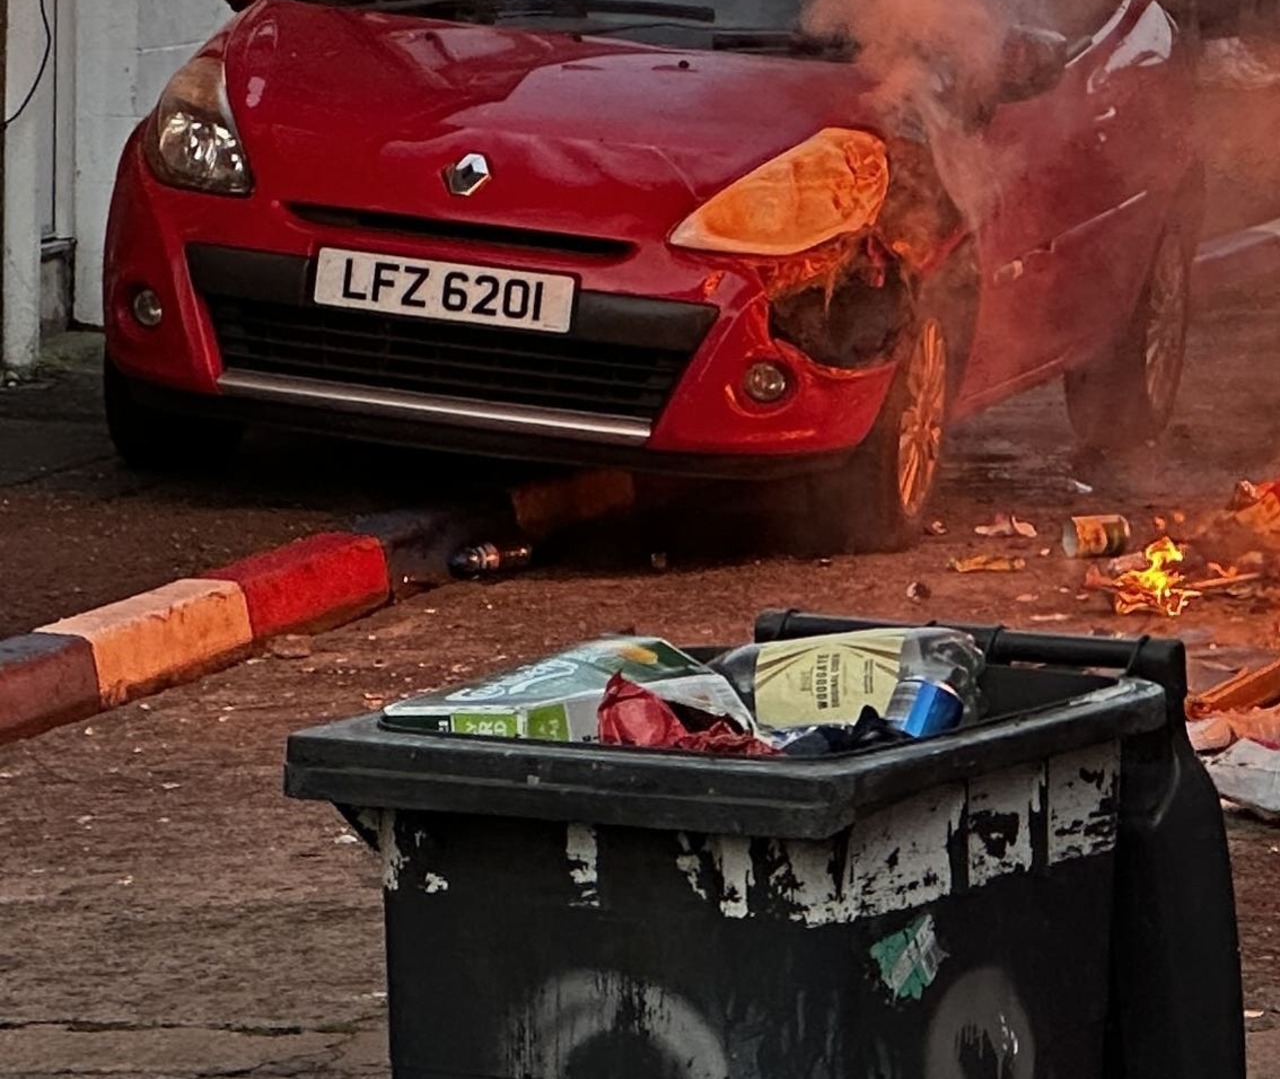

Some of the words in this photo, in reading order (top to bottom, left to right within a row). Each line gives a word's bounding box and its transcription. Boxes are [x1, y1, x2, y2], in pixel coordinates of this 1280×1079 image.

[341, 258, 430, 308] LFZ
[441, 271, 543, 321] 6201
[815, 653, 829, 710] WOODGATE
